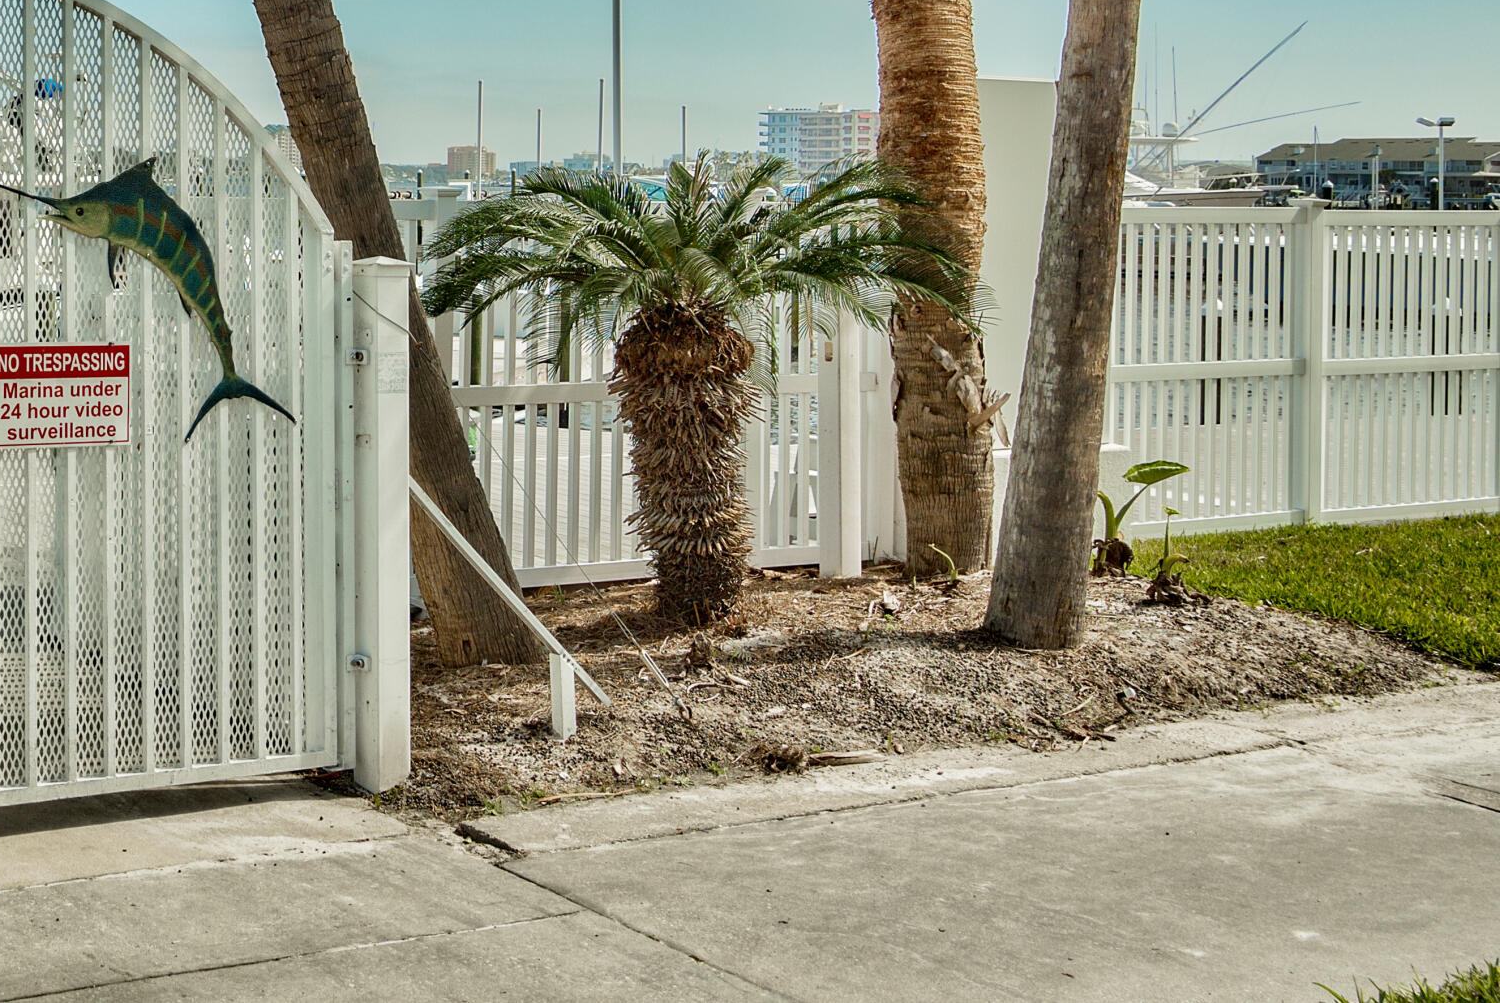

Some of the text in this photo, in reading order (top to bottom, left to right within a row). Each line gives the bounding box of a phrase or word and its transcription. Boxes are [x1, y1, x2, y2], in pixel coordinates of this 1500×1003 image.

[23, 352, 126, 372] TRESPASSING
[3, 381, 123, 399] Marina under
[0, 400, 124, 420] 24 hour video
[7, 422, 117, 441] surveillance
